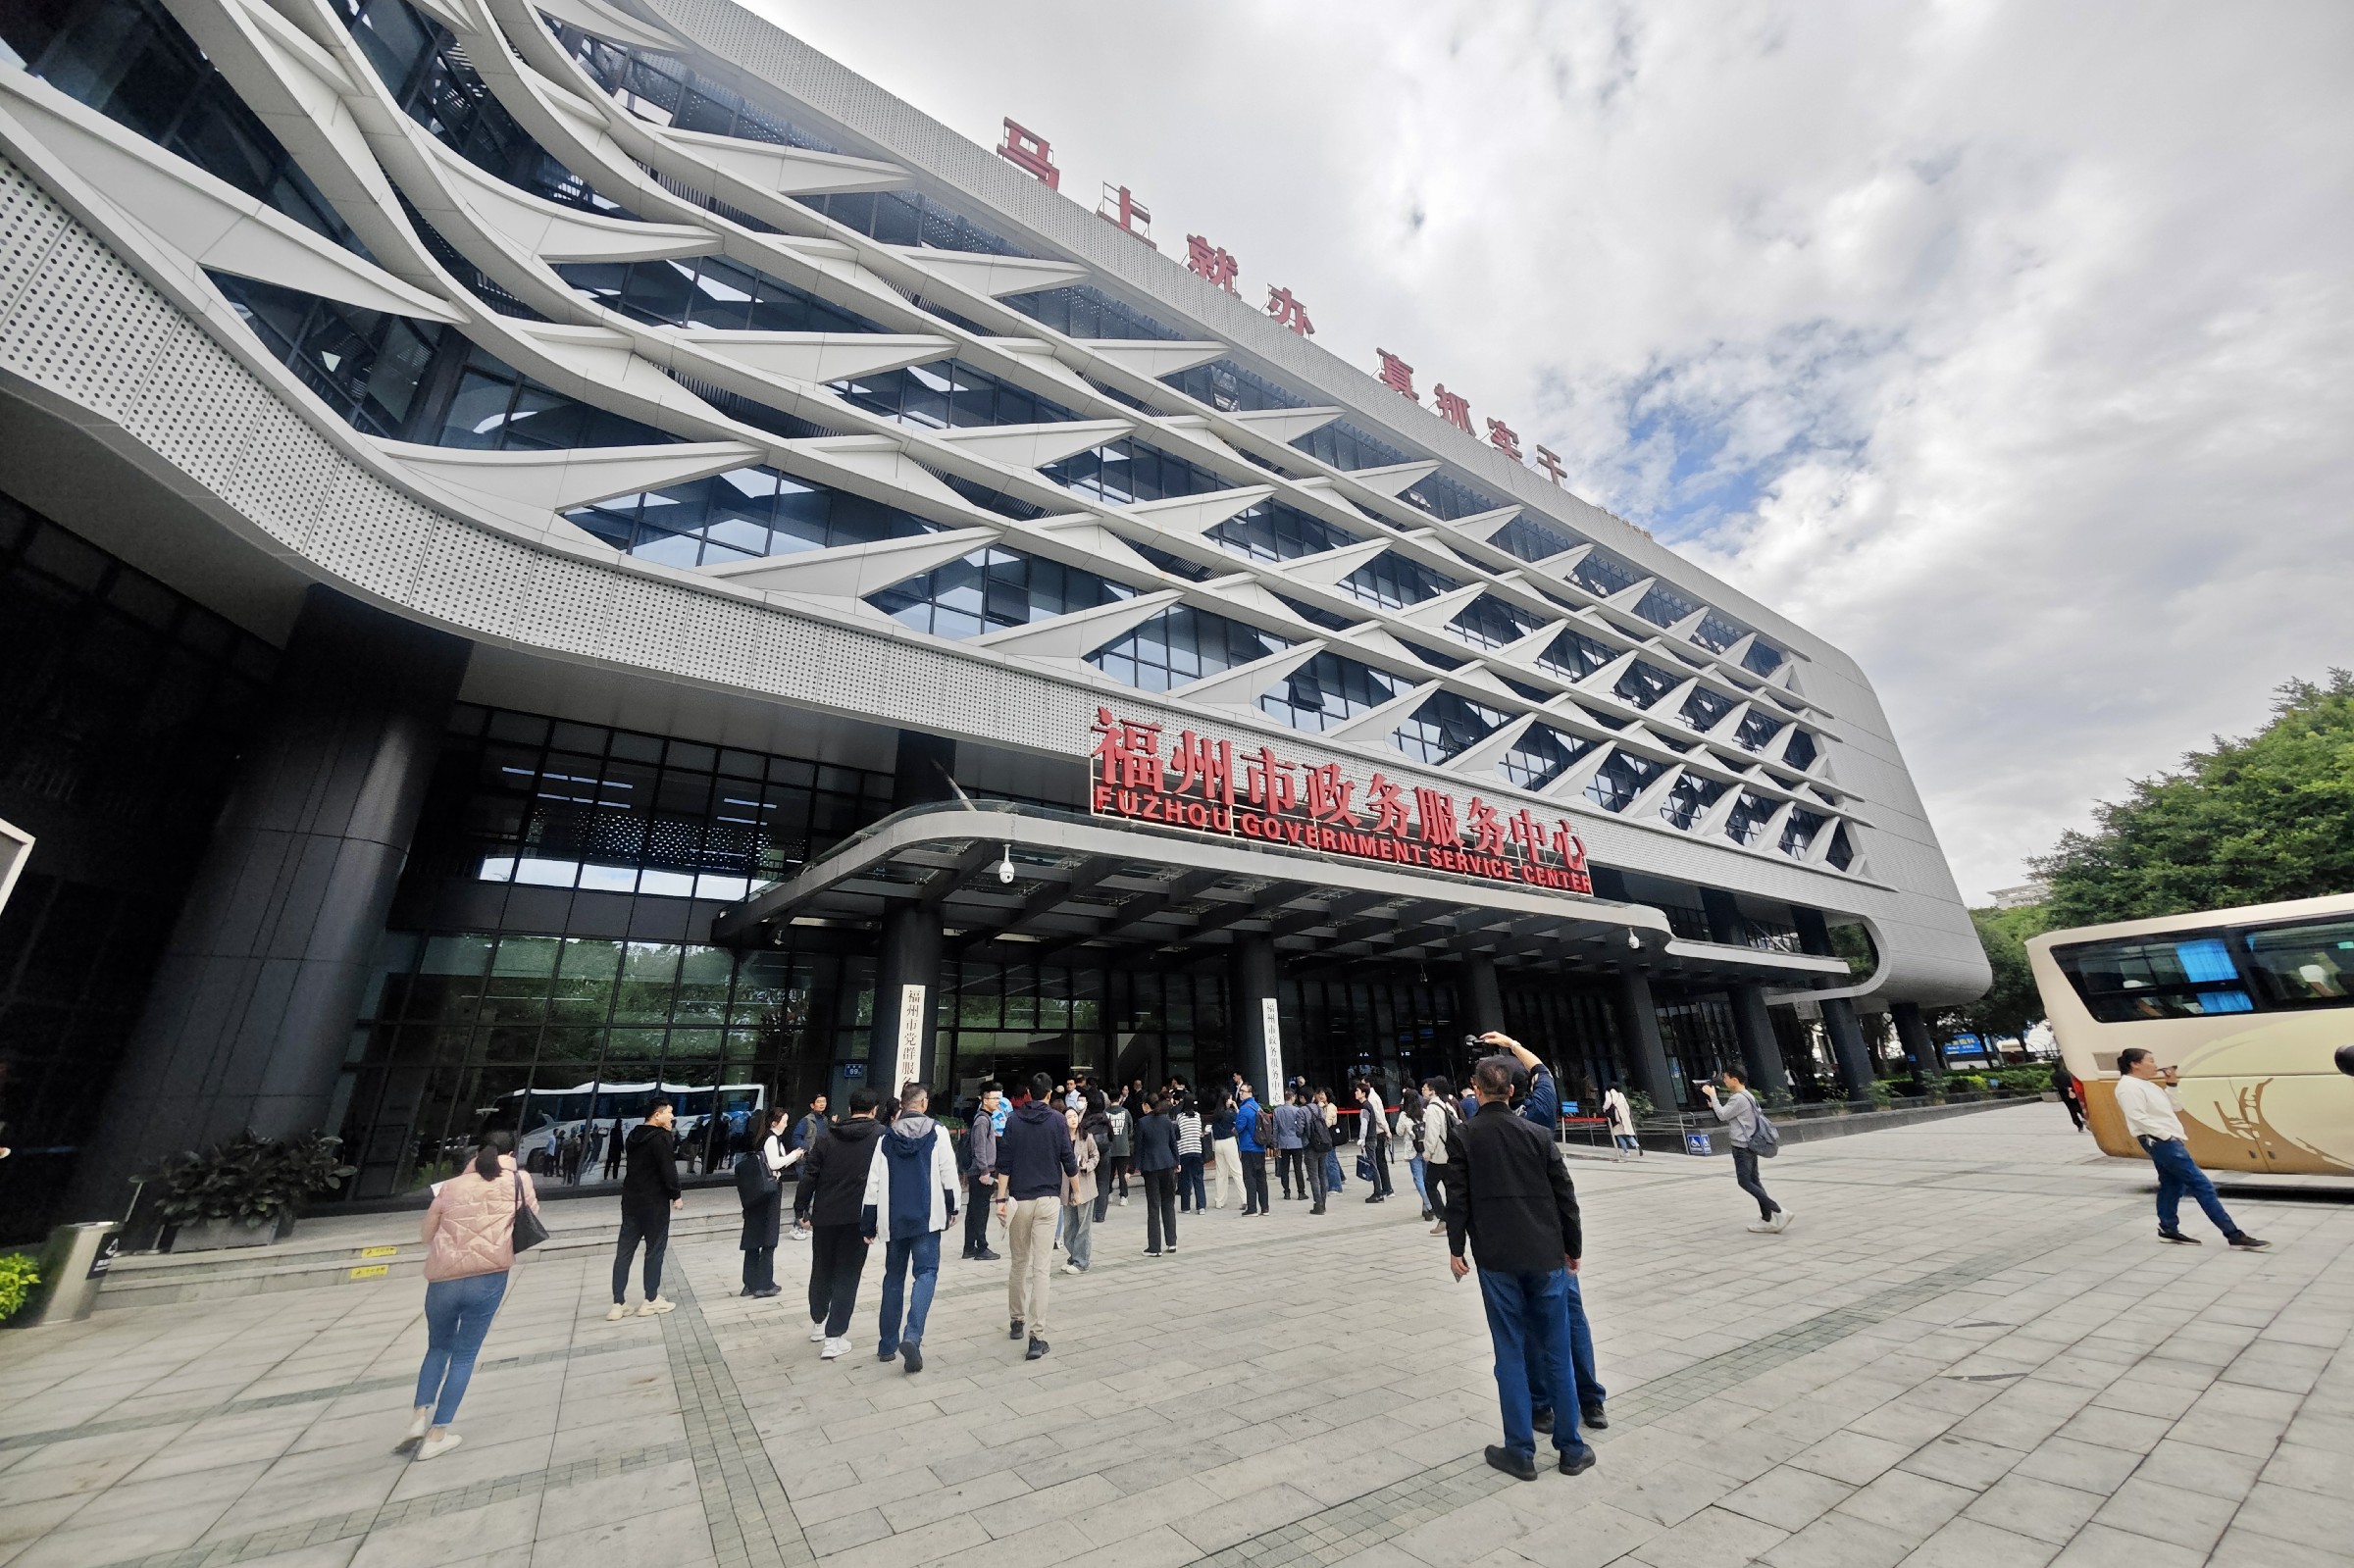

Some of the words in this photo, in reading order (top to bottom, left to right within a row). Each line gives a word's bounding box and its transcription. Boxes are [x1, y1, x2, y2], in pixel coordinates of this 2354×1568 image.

[997, 117, 1314, 336] 马上就办
[1376, 347, 1568, 485] 真抓实干
[1091, 706, 1587, 871] 福州市政务服务中心
[1094, 784, 1230, 832] FUZHOU
[1240, 813, 1423, 865] GOVERNMENT
[1427, 847, 1514, 879] SERVICE
[1522, 864, 1592, 894] CENTER
